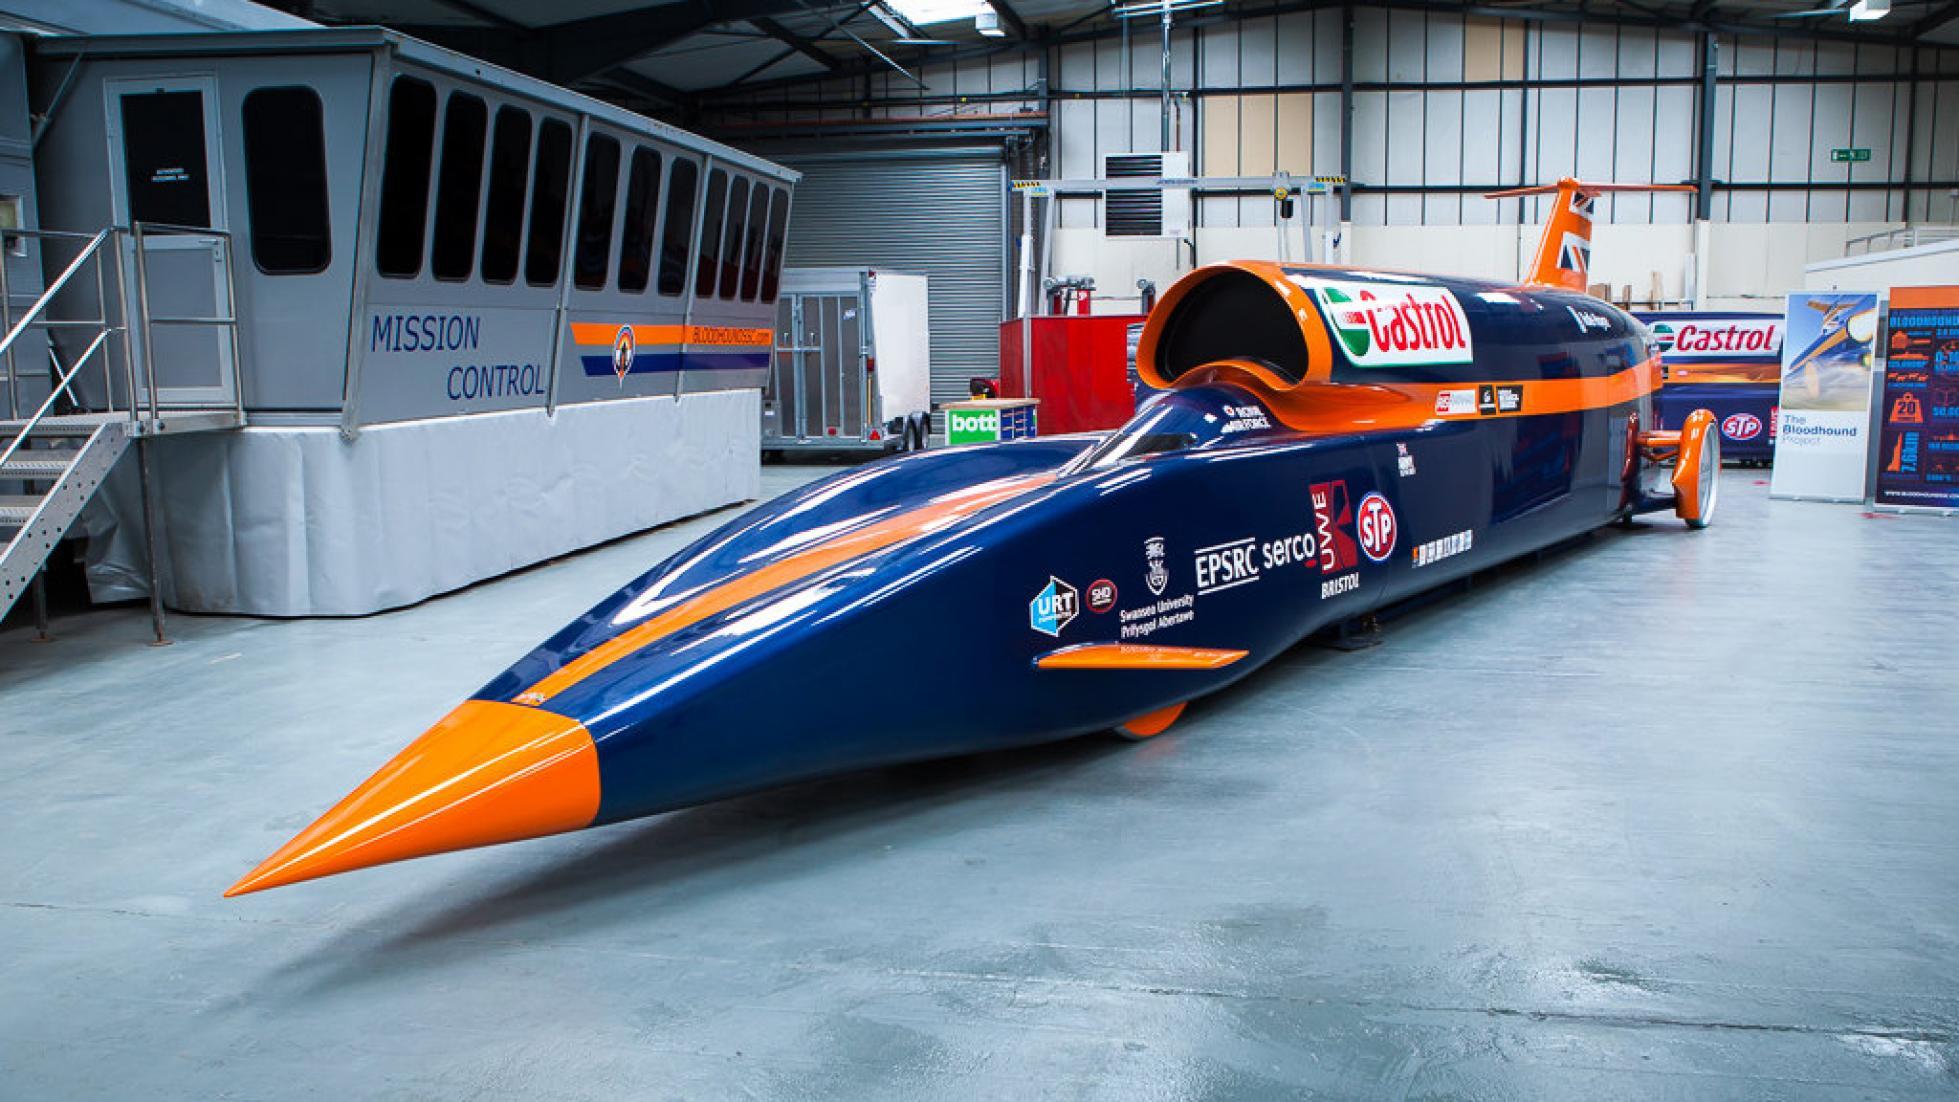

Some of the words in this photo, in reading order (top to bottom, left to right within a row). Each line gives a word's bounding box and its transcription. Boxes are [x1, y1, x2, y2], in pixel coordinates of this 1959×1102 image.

[371, 315, 481, 352] MISSION
[1360, 289, 1467, 352] Castrol
[1676, 324, 1777, 351] Castrol
[447, 364, 546, 400] CONTROL
[952, 413, 997, 432] bott
[1724, 416, 1758, 436] STP
[1782, 425, 1857, 437] Bloodhound
[1784, 414, 1807, 425] The
[1311, 491, 1335, 571] UWE
[1363, 502, 1392, 552] STP
[1195, 544, 1259, 588] EPSRC
[1262, 533, 1316, 570] serco
[1320, 572, 1361, 600] BRISTOL
[1037, 592, 1074, 615] URT
[1120, 604, 1157, 622] Swansea
[1156, 594, 1195, 616] University
